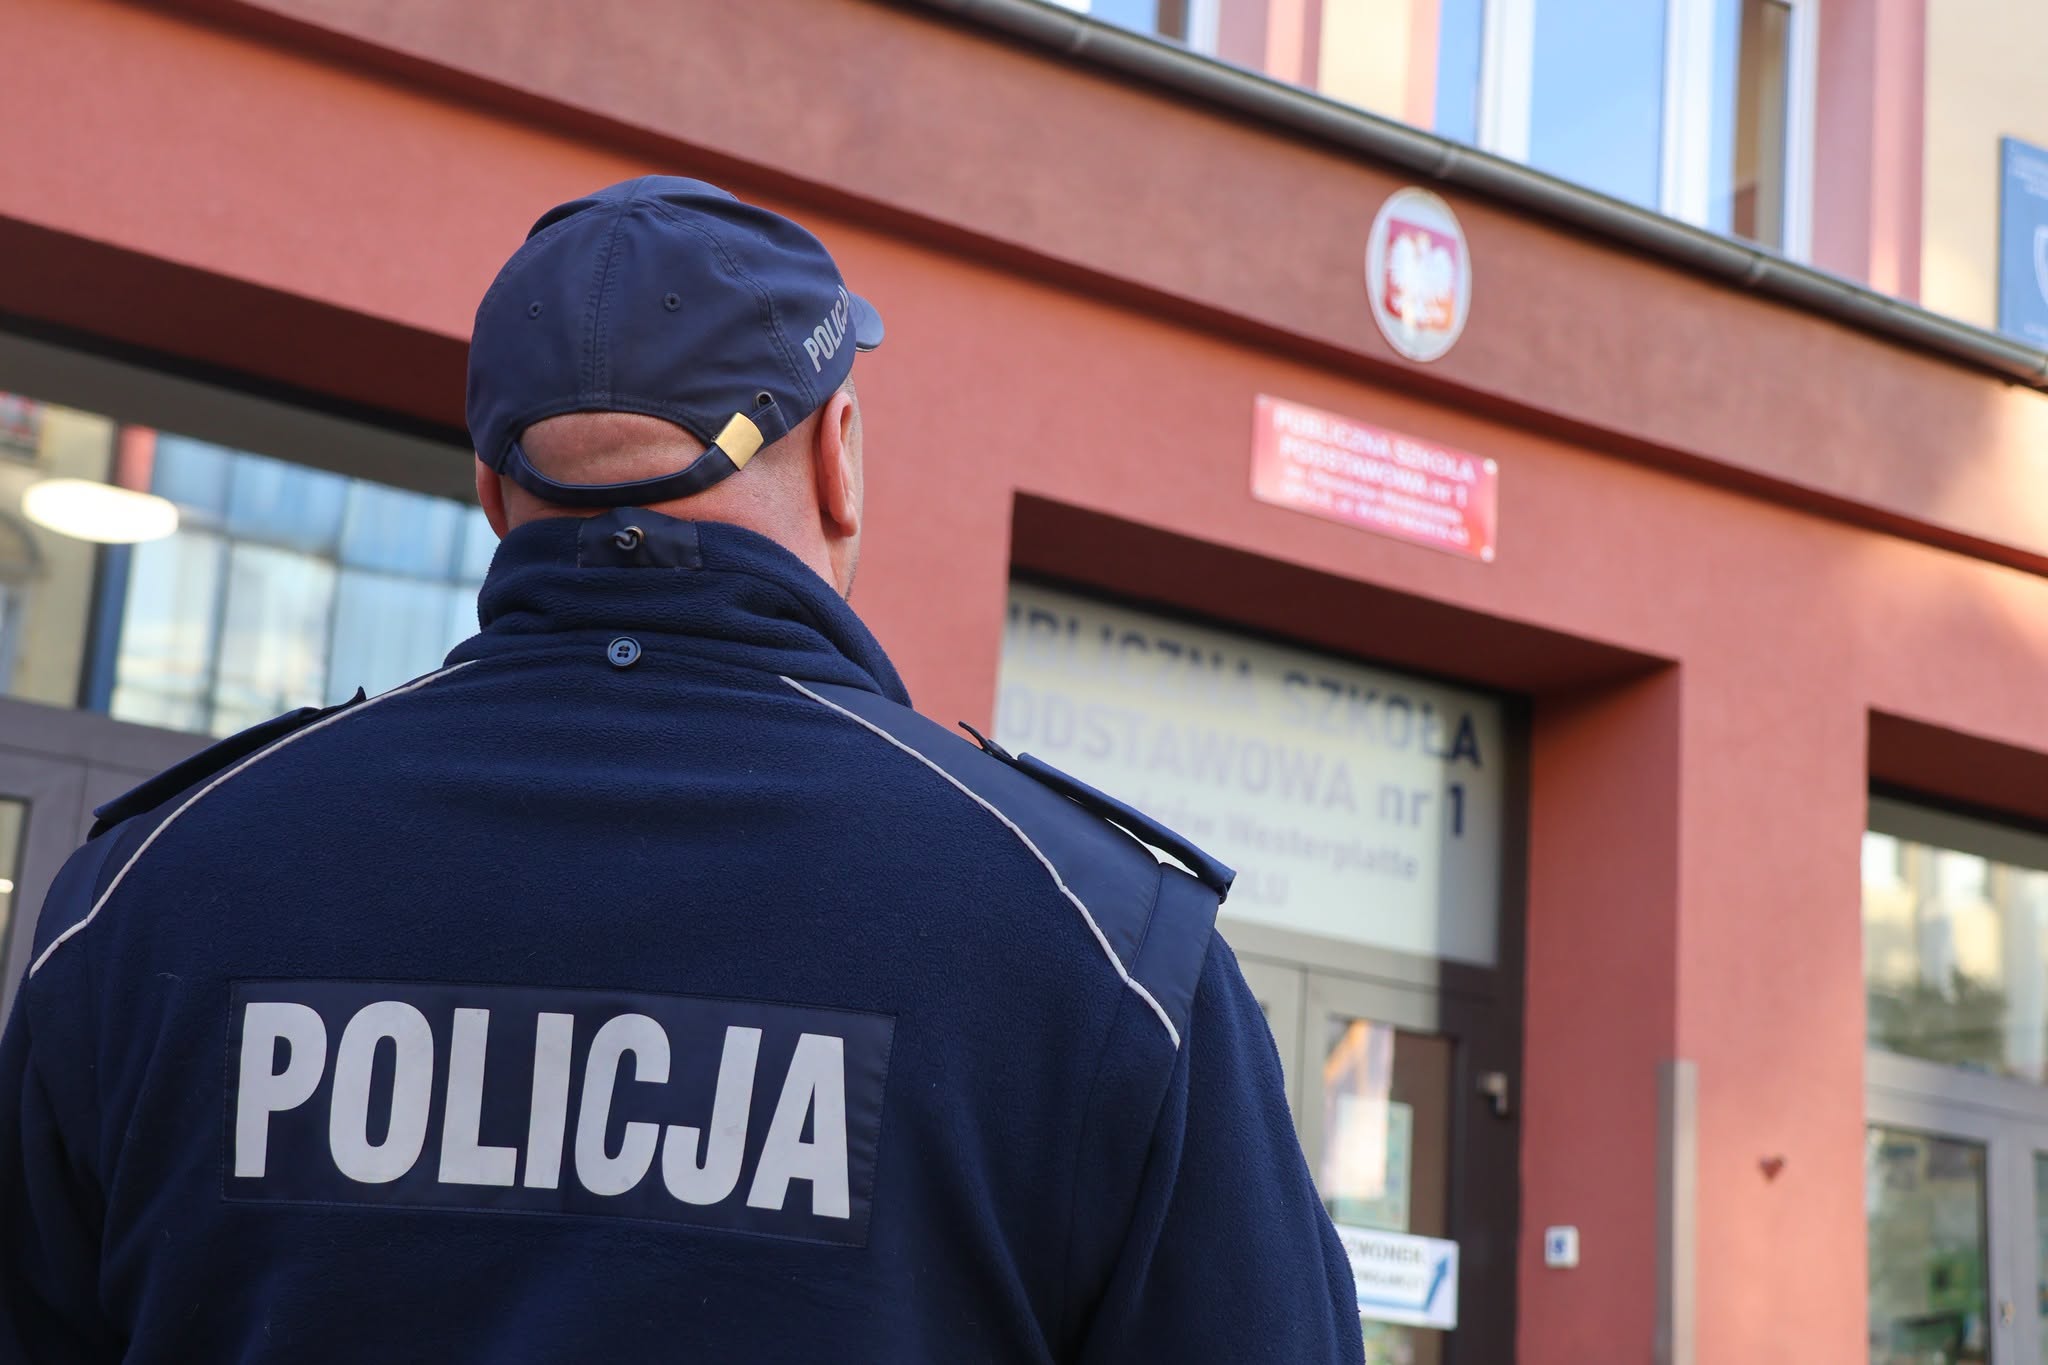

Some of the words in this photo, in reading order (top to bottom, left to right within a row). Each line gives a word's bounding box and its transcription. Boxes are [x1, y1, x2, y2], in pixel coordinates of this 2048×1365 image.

[1273, 405, 1391, 458] PUBLICZNA
[1280, 436, 1428, 494] PODSTAWOWA
[1430, 480, 1452, 502] nr
[1455, 483, 1468, 508] 1
[1281, 668, 1483, 769] SZKOŁA
[1379, 780, 1434, 829] nr
[1447, 785, 1466, 839] 1
[235, 1001, 850, 1220] POLICJA
